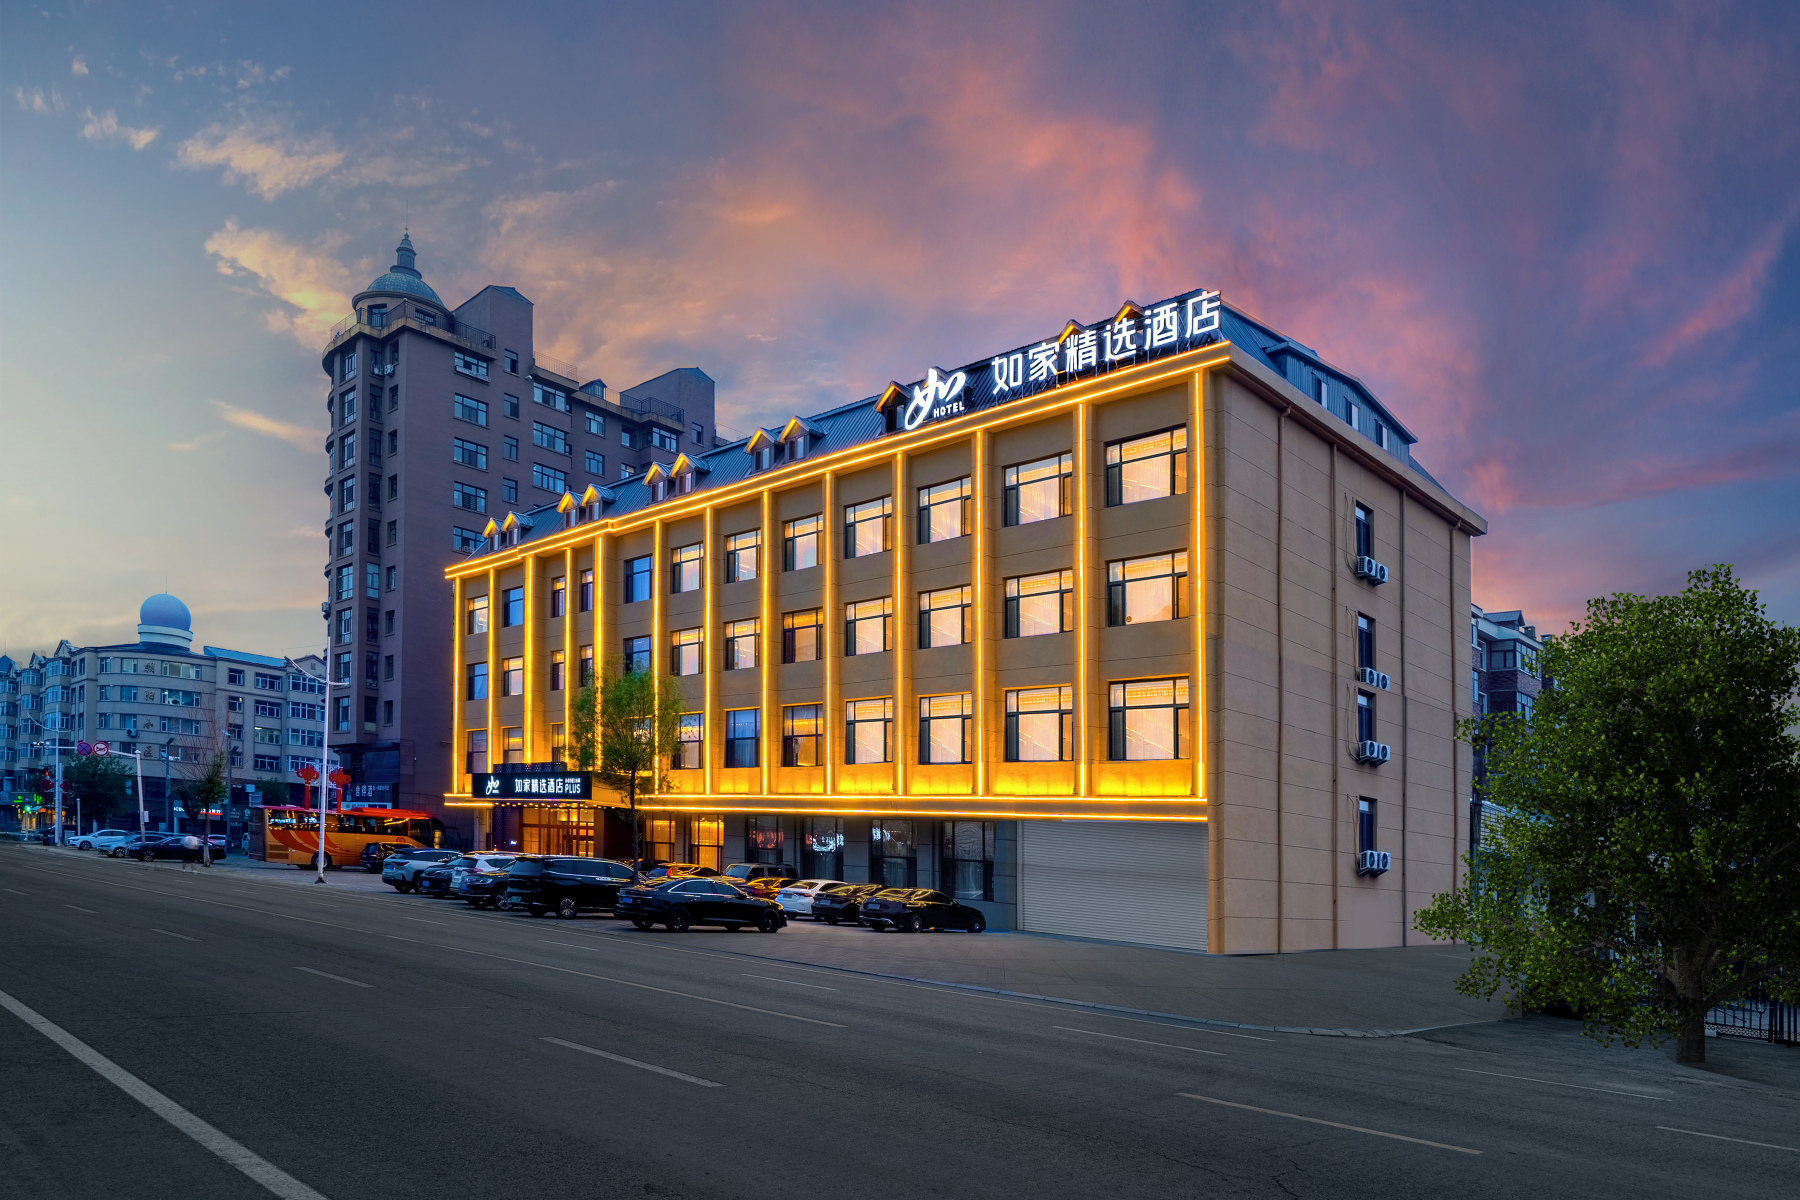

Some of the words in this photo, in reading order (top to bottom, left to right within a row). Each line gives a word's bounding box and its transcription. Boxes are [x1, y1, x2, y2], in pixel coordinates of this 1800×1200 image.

[991, 290, 1221, 395] 如家精选酒店
[933, 401, 965, 418] HOTEL
[514, 778, 564, 794] 如家精选酒店
[564, 783, 581, 794] PLUS
